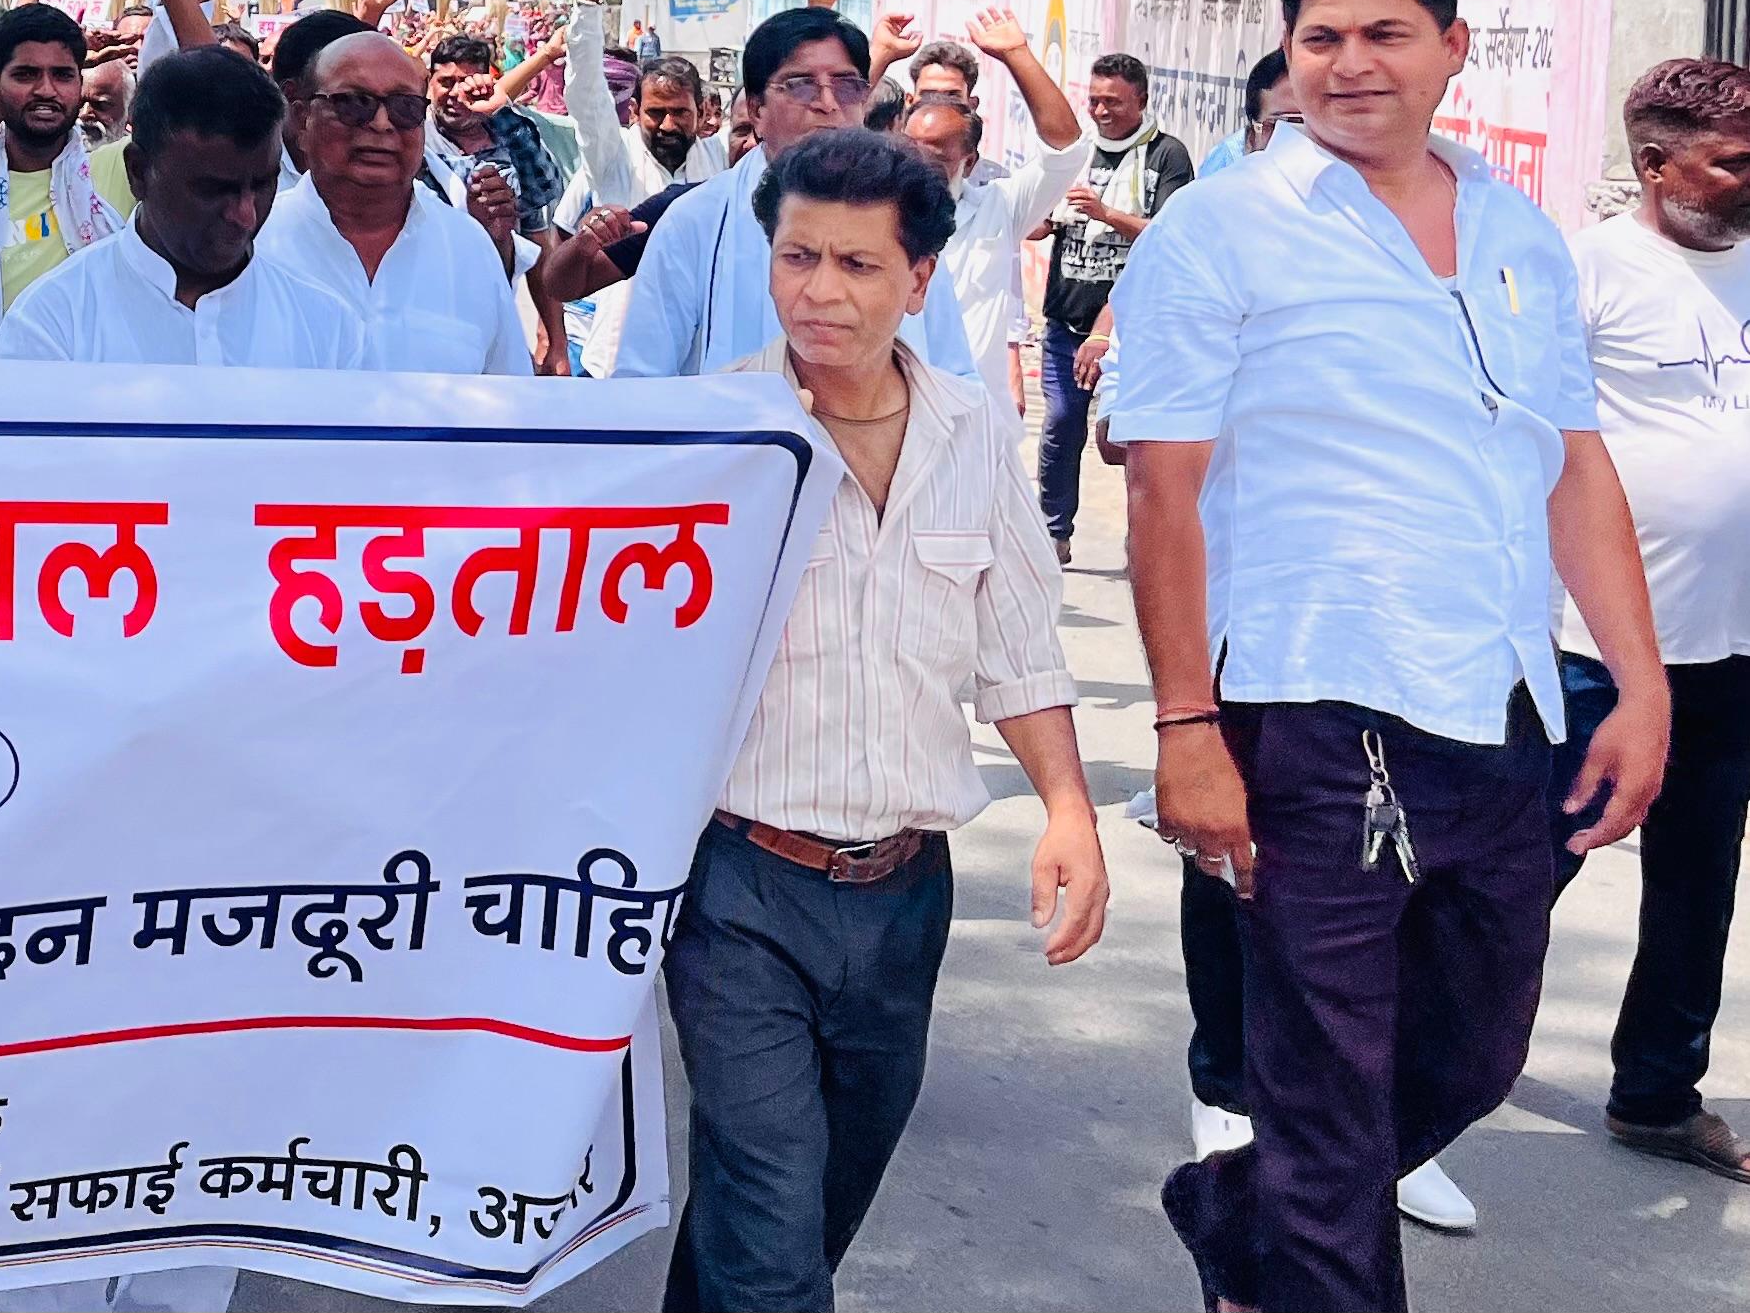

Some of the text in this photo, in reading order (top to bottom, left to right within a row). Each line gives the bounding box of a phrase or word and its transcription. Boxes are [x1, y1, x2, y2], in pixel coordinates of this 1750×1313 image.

[1703, 395, 1726, 412] My
[254, 503, 730, 674] हड़ताल
[133, 849, 440, 983] मजदूरी
[9, 1141, 191, 1222] सफाई
